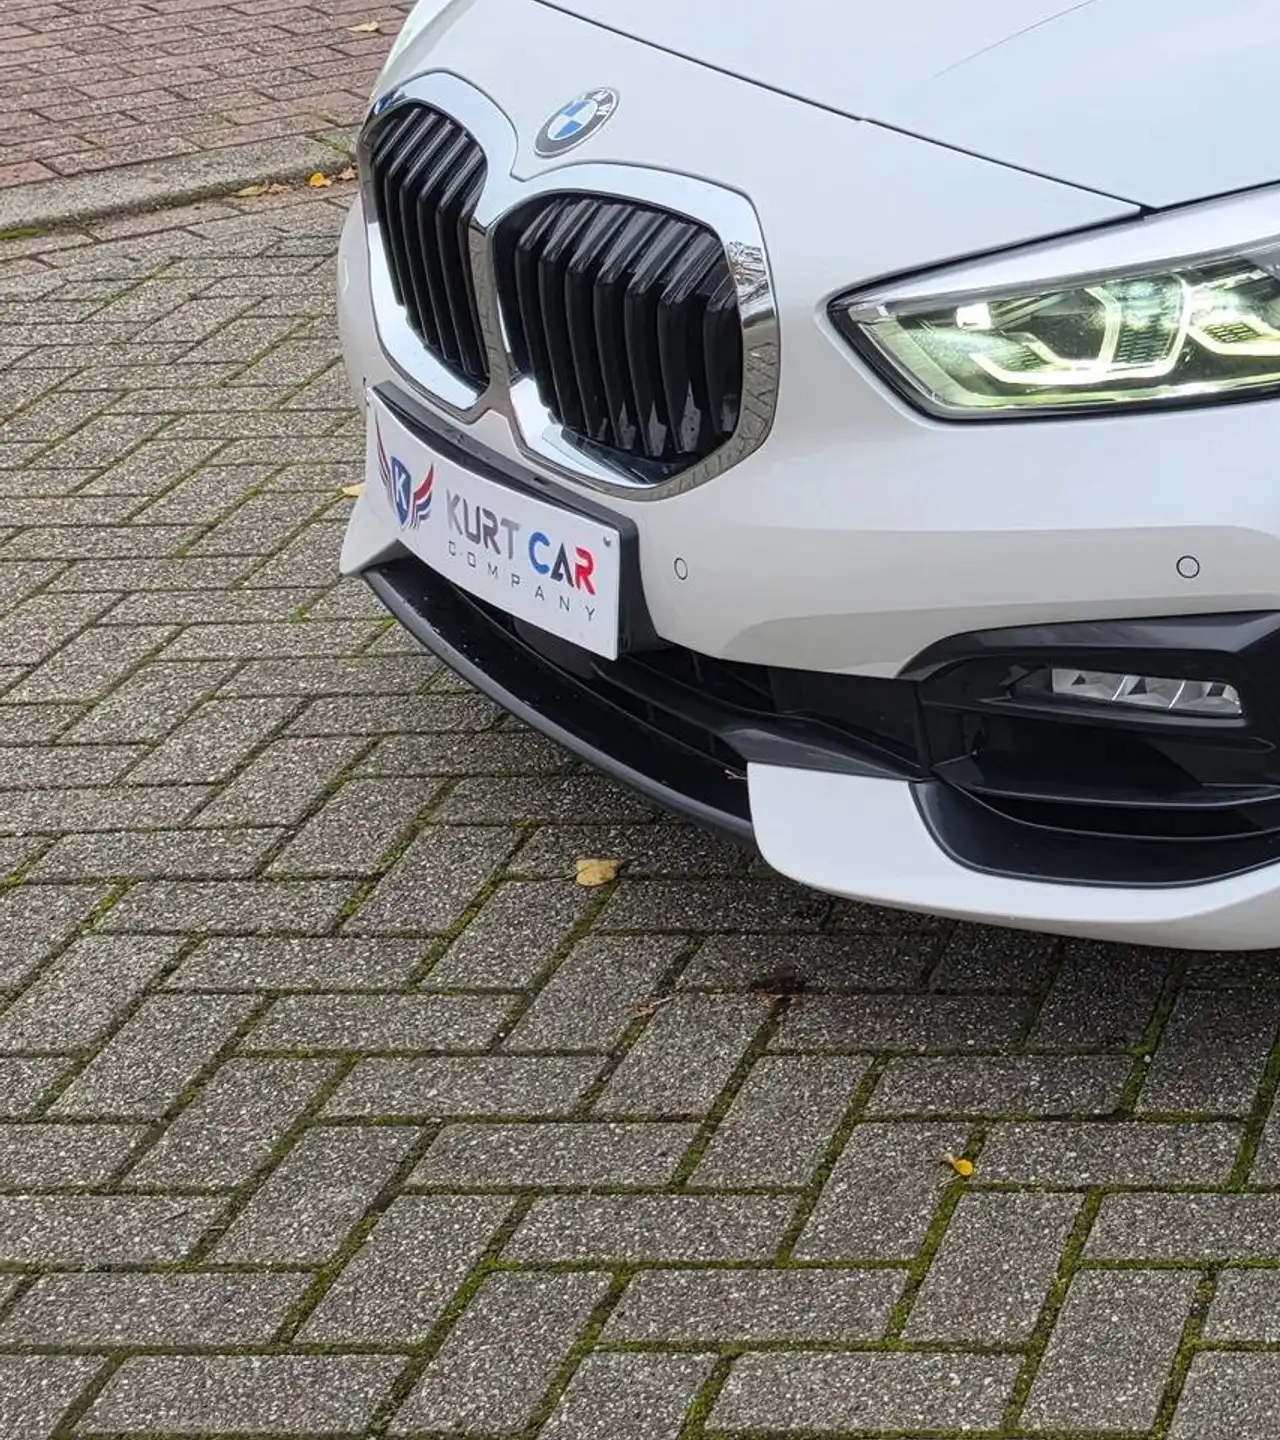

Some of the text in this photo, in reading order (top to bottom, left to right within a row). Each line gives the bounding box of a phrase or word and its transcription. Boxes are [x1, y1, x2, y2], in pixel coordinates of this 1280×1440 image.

[446, 488, 597, 596] KURT CAR
[447, 539, 597, 623] COMPANY
